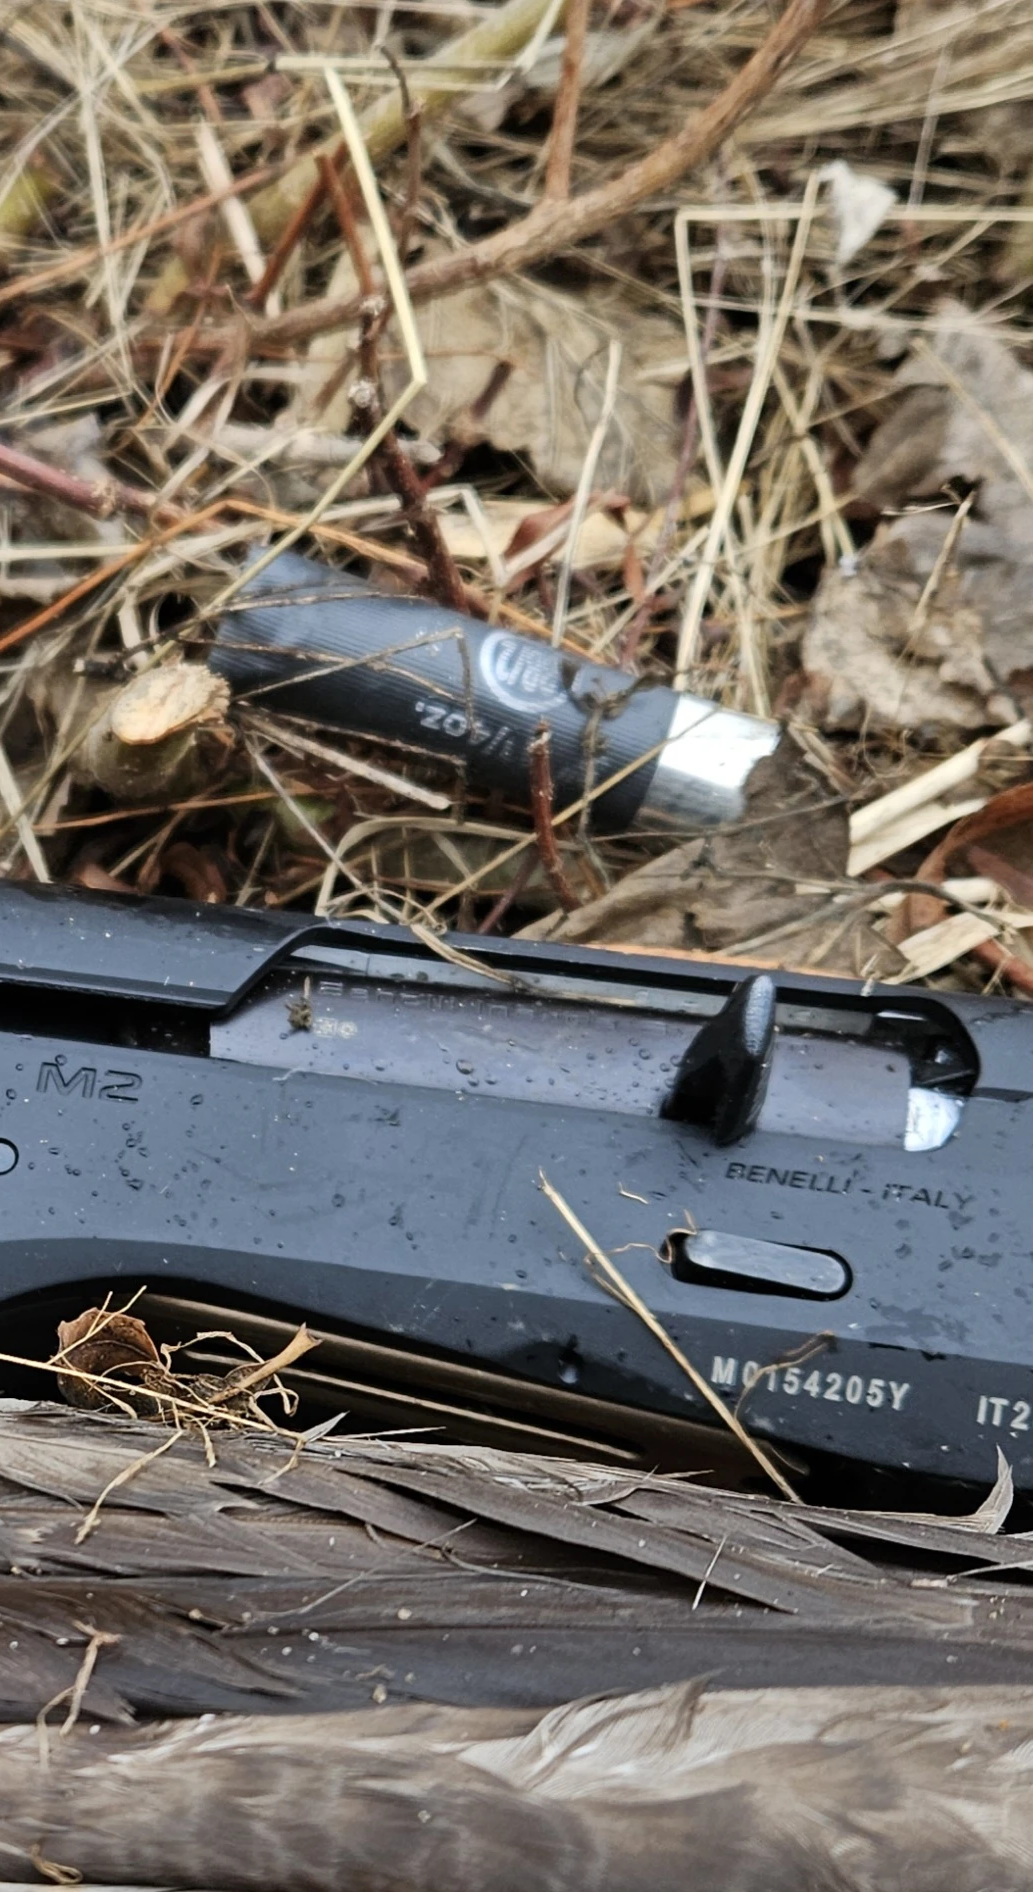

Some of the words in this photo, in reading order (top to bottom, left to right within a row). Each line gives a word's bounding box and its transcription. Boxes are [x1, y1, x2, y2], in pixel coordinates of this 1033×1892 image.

[36, 1061, 143, 1103] M2
[725, 1161, 852, 1195] BENELLI
[881, 1182, 974, 1211] ITALY
